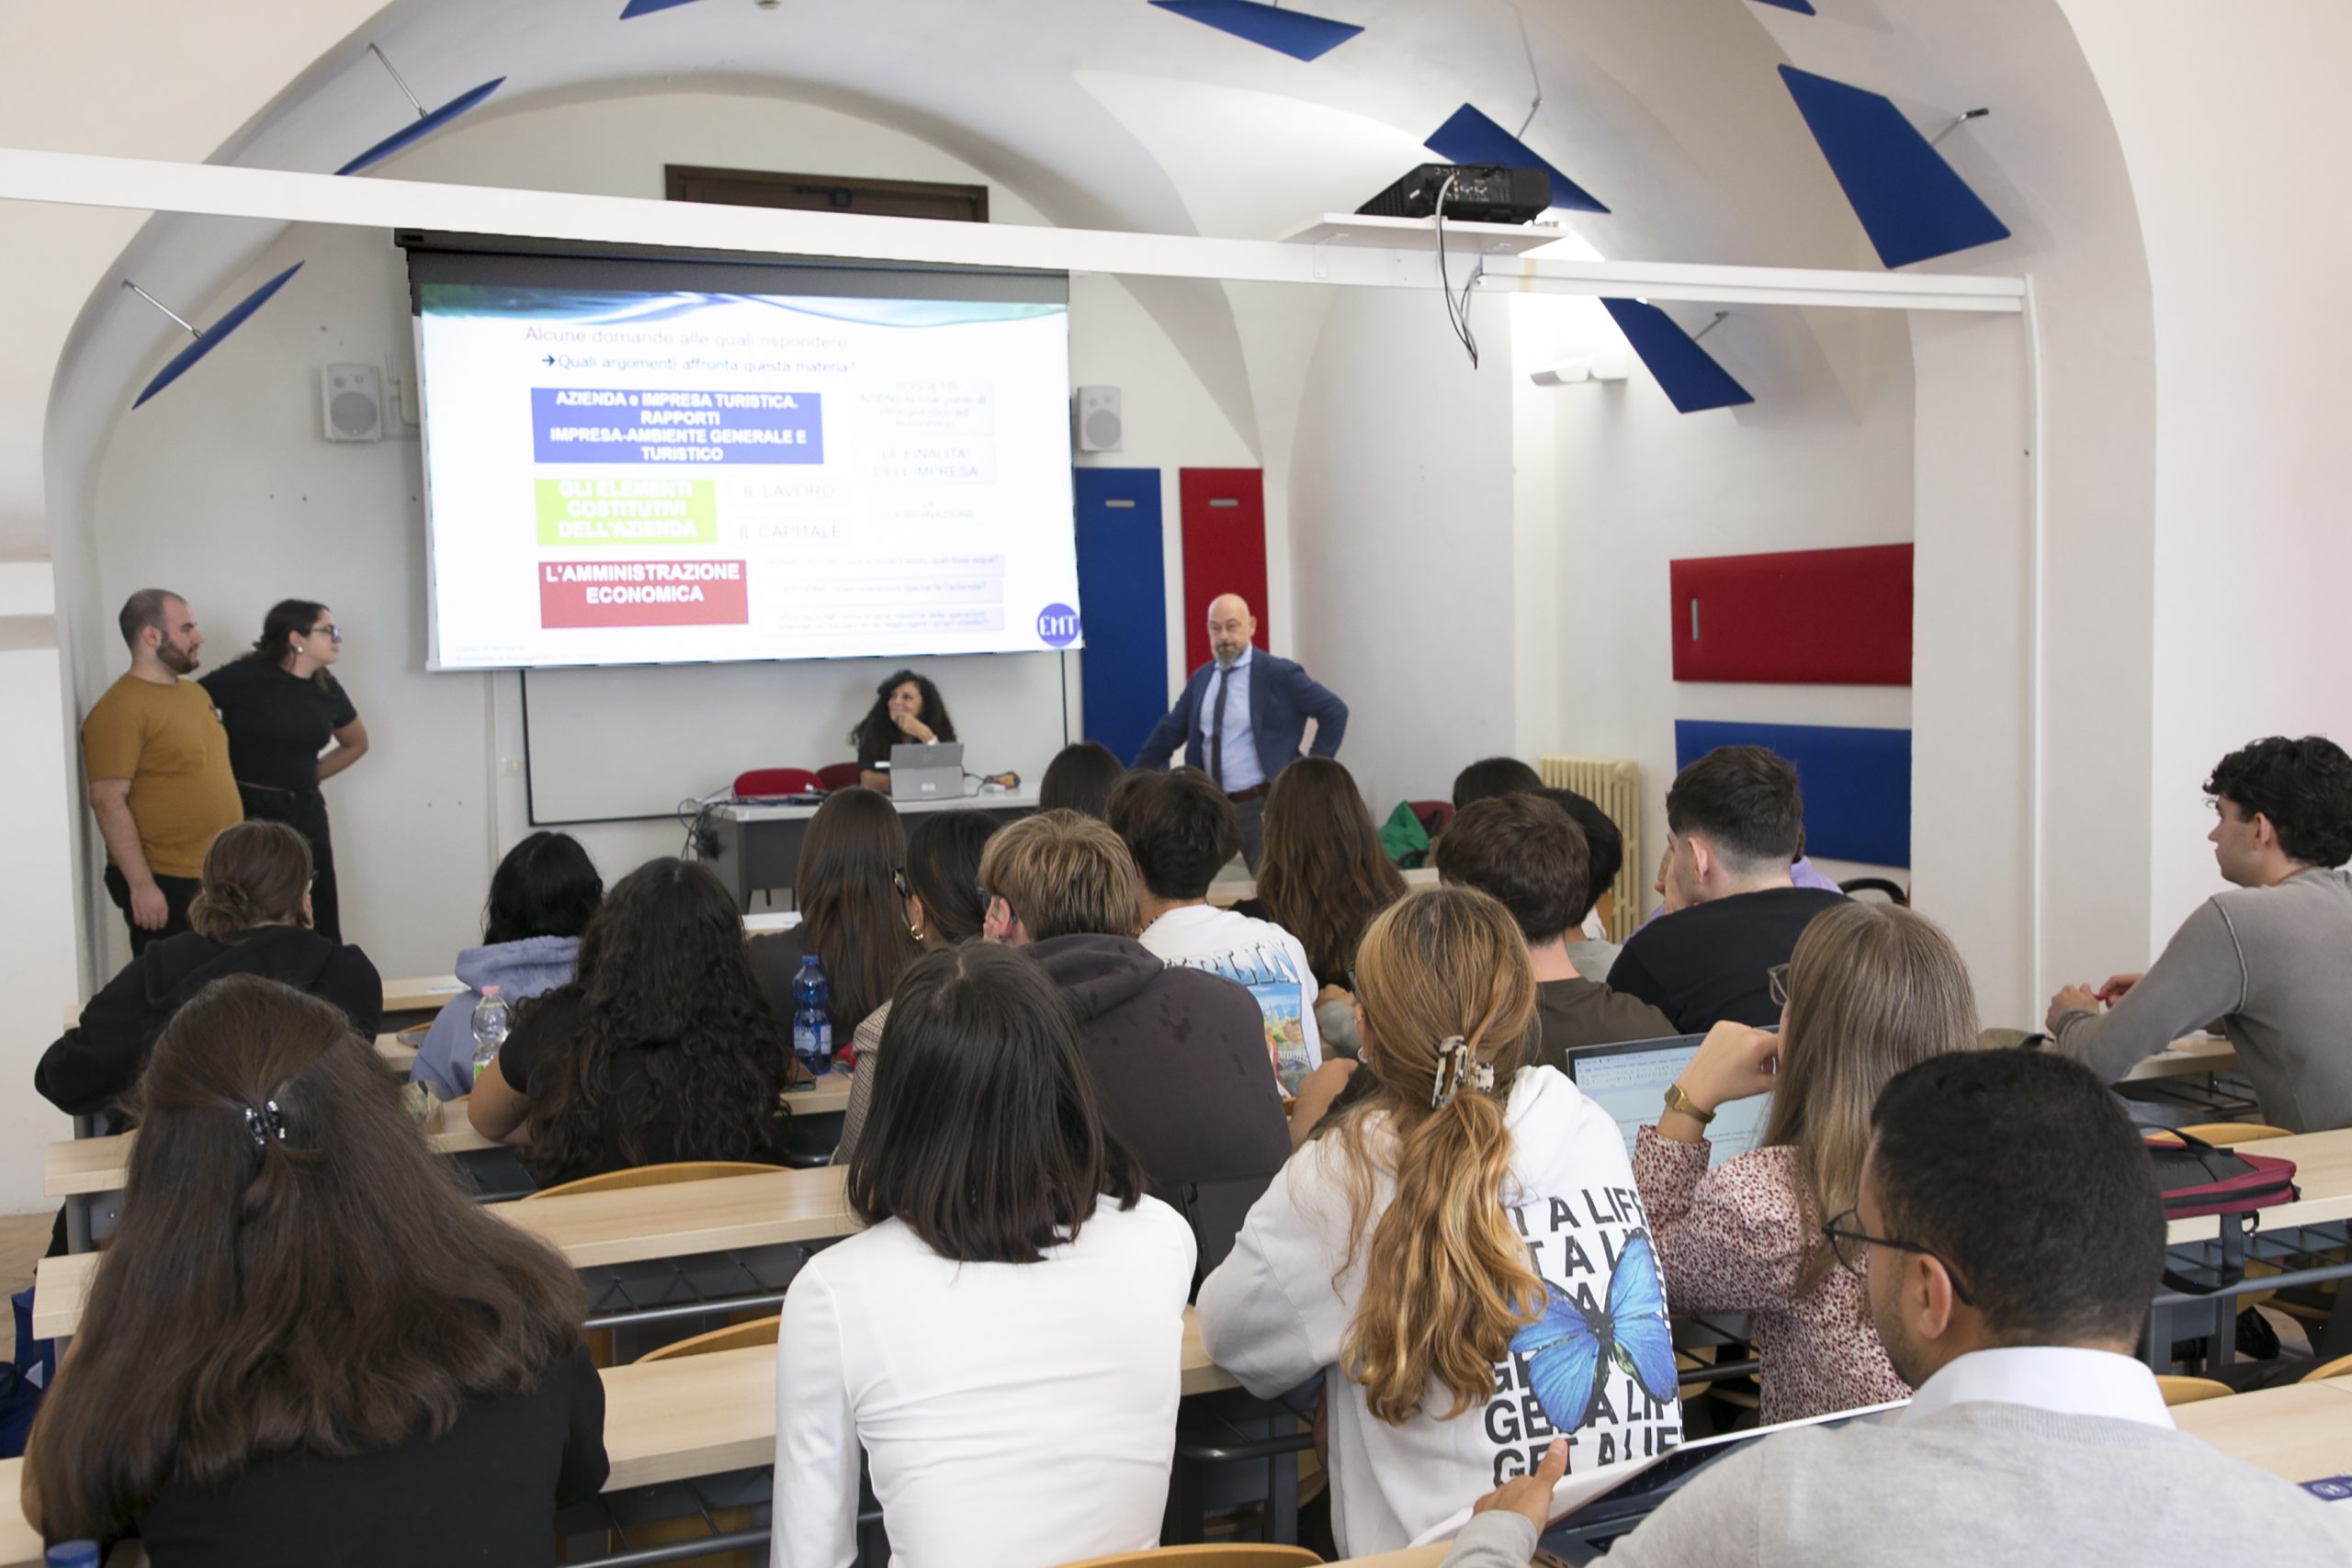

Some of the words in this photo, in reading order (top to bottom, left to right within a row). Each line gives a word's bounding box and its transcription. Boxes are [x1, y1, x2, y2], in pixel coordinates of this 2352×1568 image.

[525, 327, 586, 344] Alcune
[593, 329, 673, 345] domande
[680, 331, 708, 345] alle
[715, 332, 754, 348] quali
[761, 333, 847, 350] rispondere
[558, 355, 596, 371] Quali
[603, 356, 676, 372] argomenti
[682, 357, 739, 371] affronta
[743, 359, 790, 374] questa
[796, 360, 855, 374] materia?
[556, 390, 627, 407] AZIENDA
[629, 393, 639, 407] e
[642, 392, 712, 408] IMPRESA
[715, 392, 798, 410] TURISTICA.
[640, 410, 720, 426] RAPPORTI
[550, 427, 707, 444] IMPRESA-AMBIENTE
[710, 429, 793, 445] GENERALE
[797, 430, 807, 445] E
[641, 446, 724, 462] TURISTICO
[559, 479, 592, 498] GLI
[597, 479, 694, 498] ELEMENTI
[743, 484, 755, 499] IL
[763, 484, 836, 499] LAVORO
[567, 501, 687, 518] COSTITUTIVI
[558, 520, 698, 538] DELL'AZIENDA
[739, 525, 752, 539] IL
[759, 524, 842, 539] CAPITALE
[546, 563, 741, 583] L'AMMINISTRAZIONE
[585, 585, 705, 604] ECONOMICA
[1039, 614, 1079, 637] EMT
